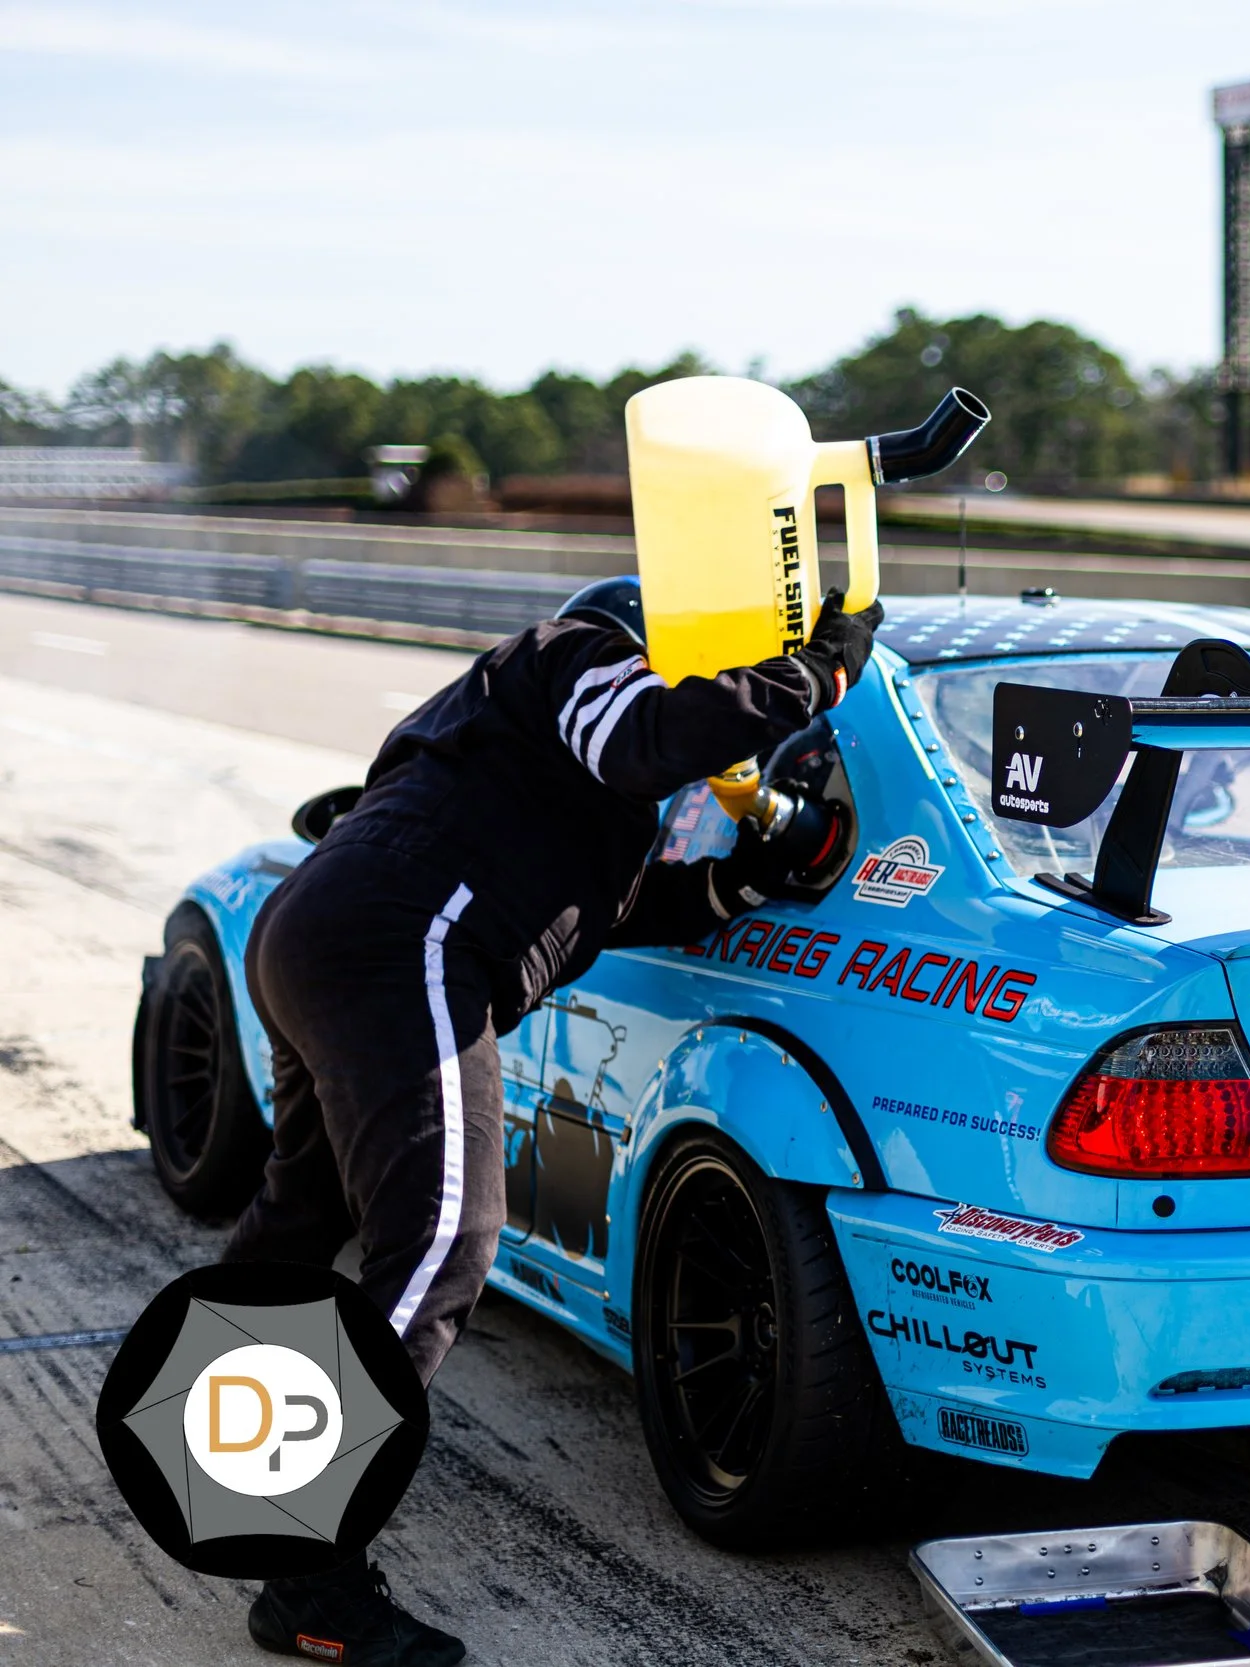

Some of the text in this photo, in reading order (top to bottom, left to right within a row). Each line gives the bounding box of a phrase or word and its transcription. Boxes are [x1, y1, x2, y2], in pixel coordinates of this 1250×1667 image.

[772, 530, 786, 633] SYSTEMS
[773, 506, 805, 656] FUEL SAFE
[1005, 752, 1044, 792] AV
[856, 858, 898, 884] AER
[684, 919, 1038, 1022] KRIEG RACING
[872, 1096, 1041, 1142] PREPARED FOR SUCCESS!
[891, 1258, 993, 1302] COOLFOX
[962, 1360, 1047, 1389] SYSTEMS
[940, 1410, 1018, 1452] RACETREADS
